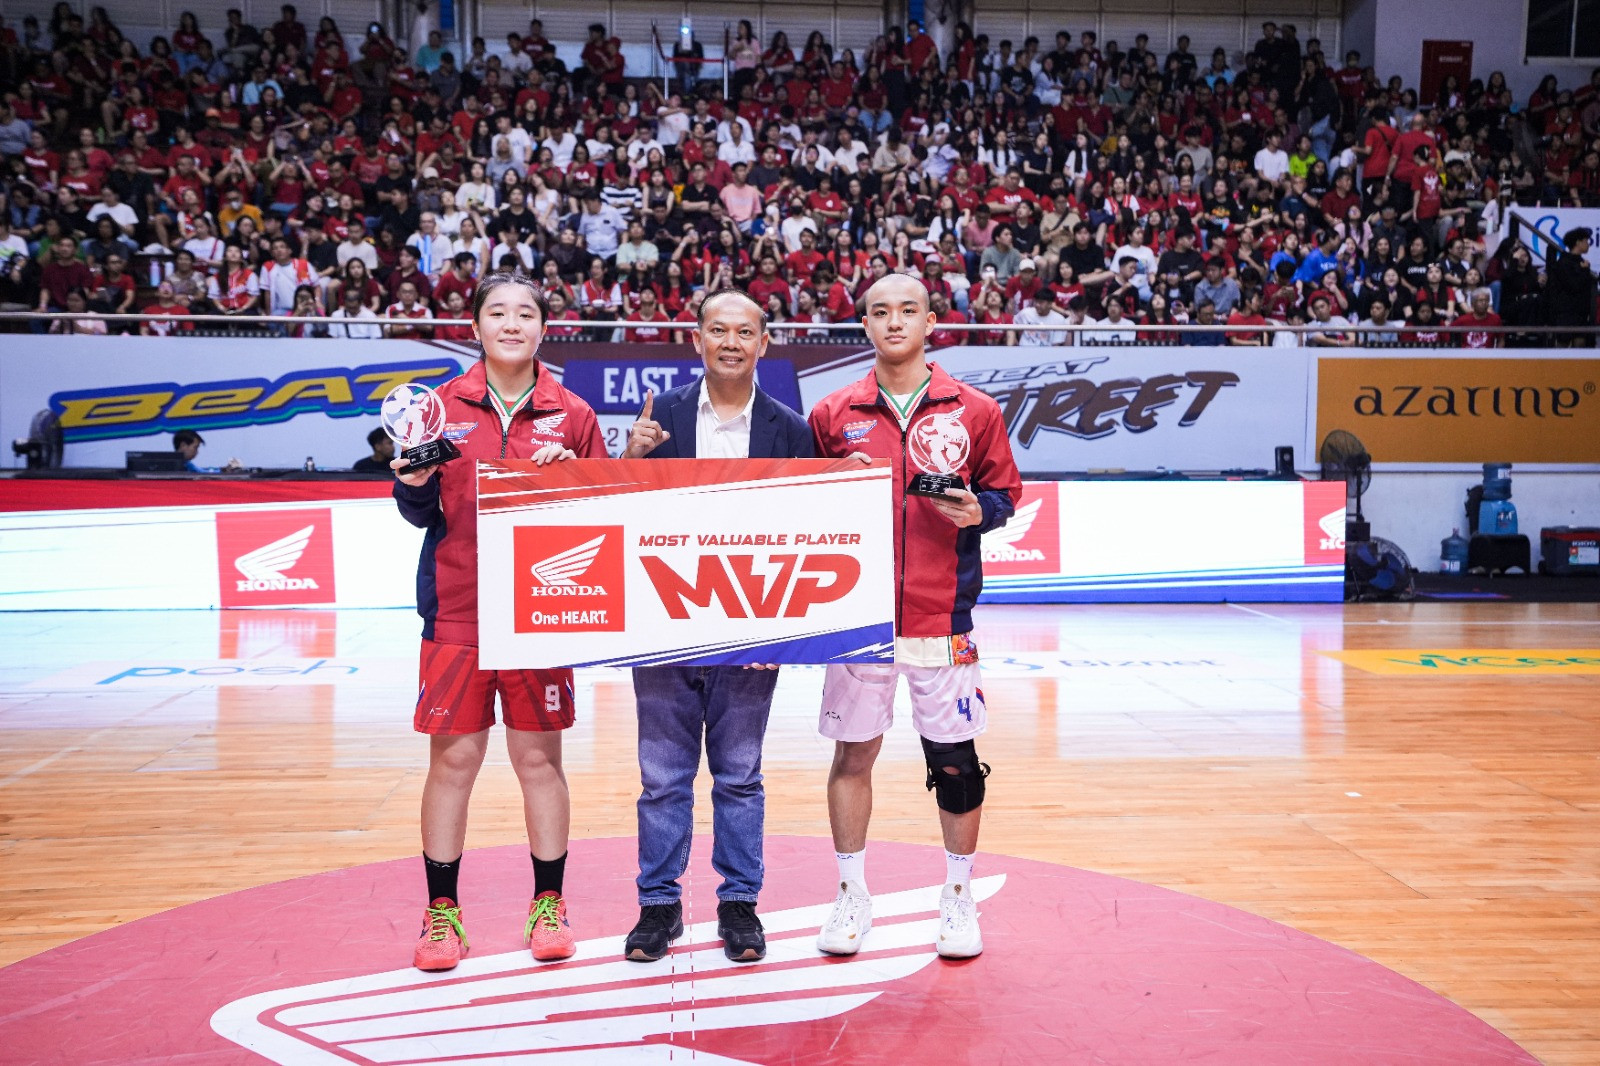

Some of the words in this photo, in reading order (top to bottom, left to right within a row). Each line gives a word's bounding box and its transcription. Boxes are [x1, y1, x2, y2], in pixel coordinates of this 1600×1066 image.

[604, 367, 679, 403] EAST
[639, 534, 690, 547] MOST
[697, 534, 787, 546] VALUABLE
[794, 533, 861, 546] PLAYER
[236, 577, 319, 592] HONDA
[531, 585, 608, 597] HONDA
[638, 553, 862, 620] MVP
[531, 610, 559, 625] One
[562, 610, 609, 625] HEART.
[95, 659, 360, 685] posh
[545, 684, 561, 712] 9
[956, 696, 972, 723] 4
